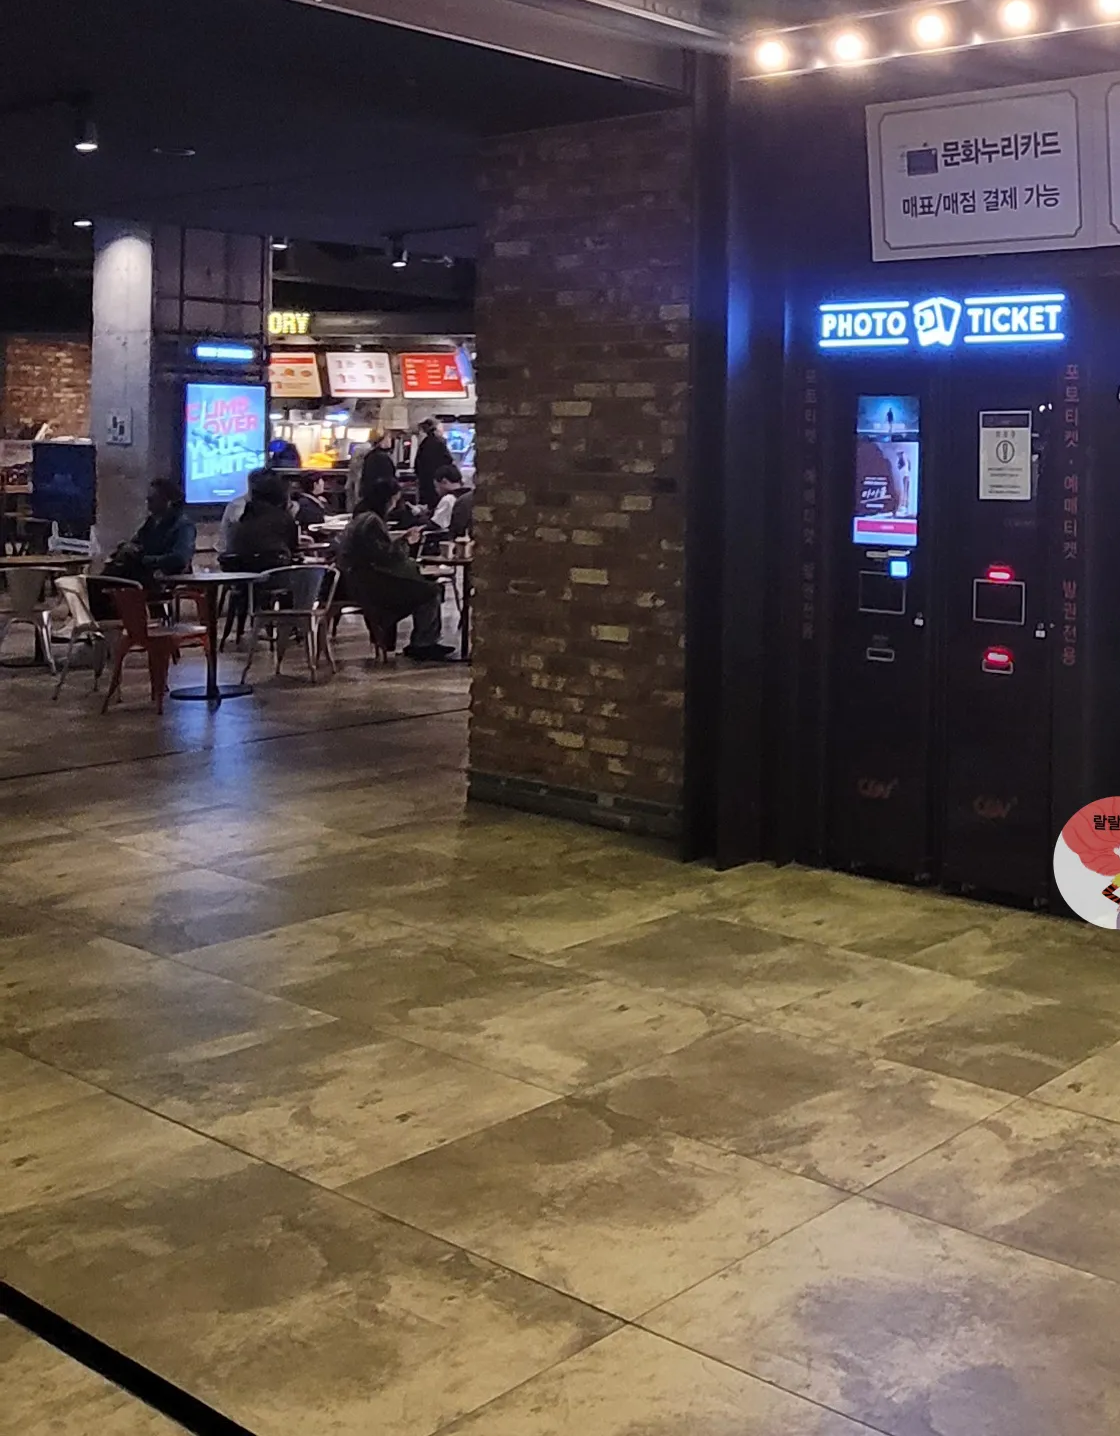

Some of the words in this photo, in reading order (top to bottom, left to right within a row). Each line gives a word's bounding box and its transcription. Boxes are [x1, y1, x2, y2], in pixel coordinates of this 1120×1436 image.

[941, 131, 1062, 168] 문화누리카드
[902, 189, 976, 219] 매표/매점
[983, 185, 1019, 212] 결제
[1024, 183, 1061, 208] 가능
[821, 310, 907, 338] PHOTO
[966, 304, 1063, 333] TICKET
